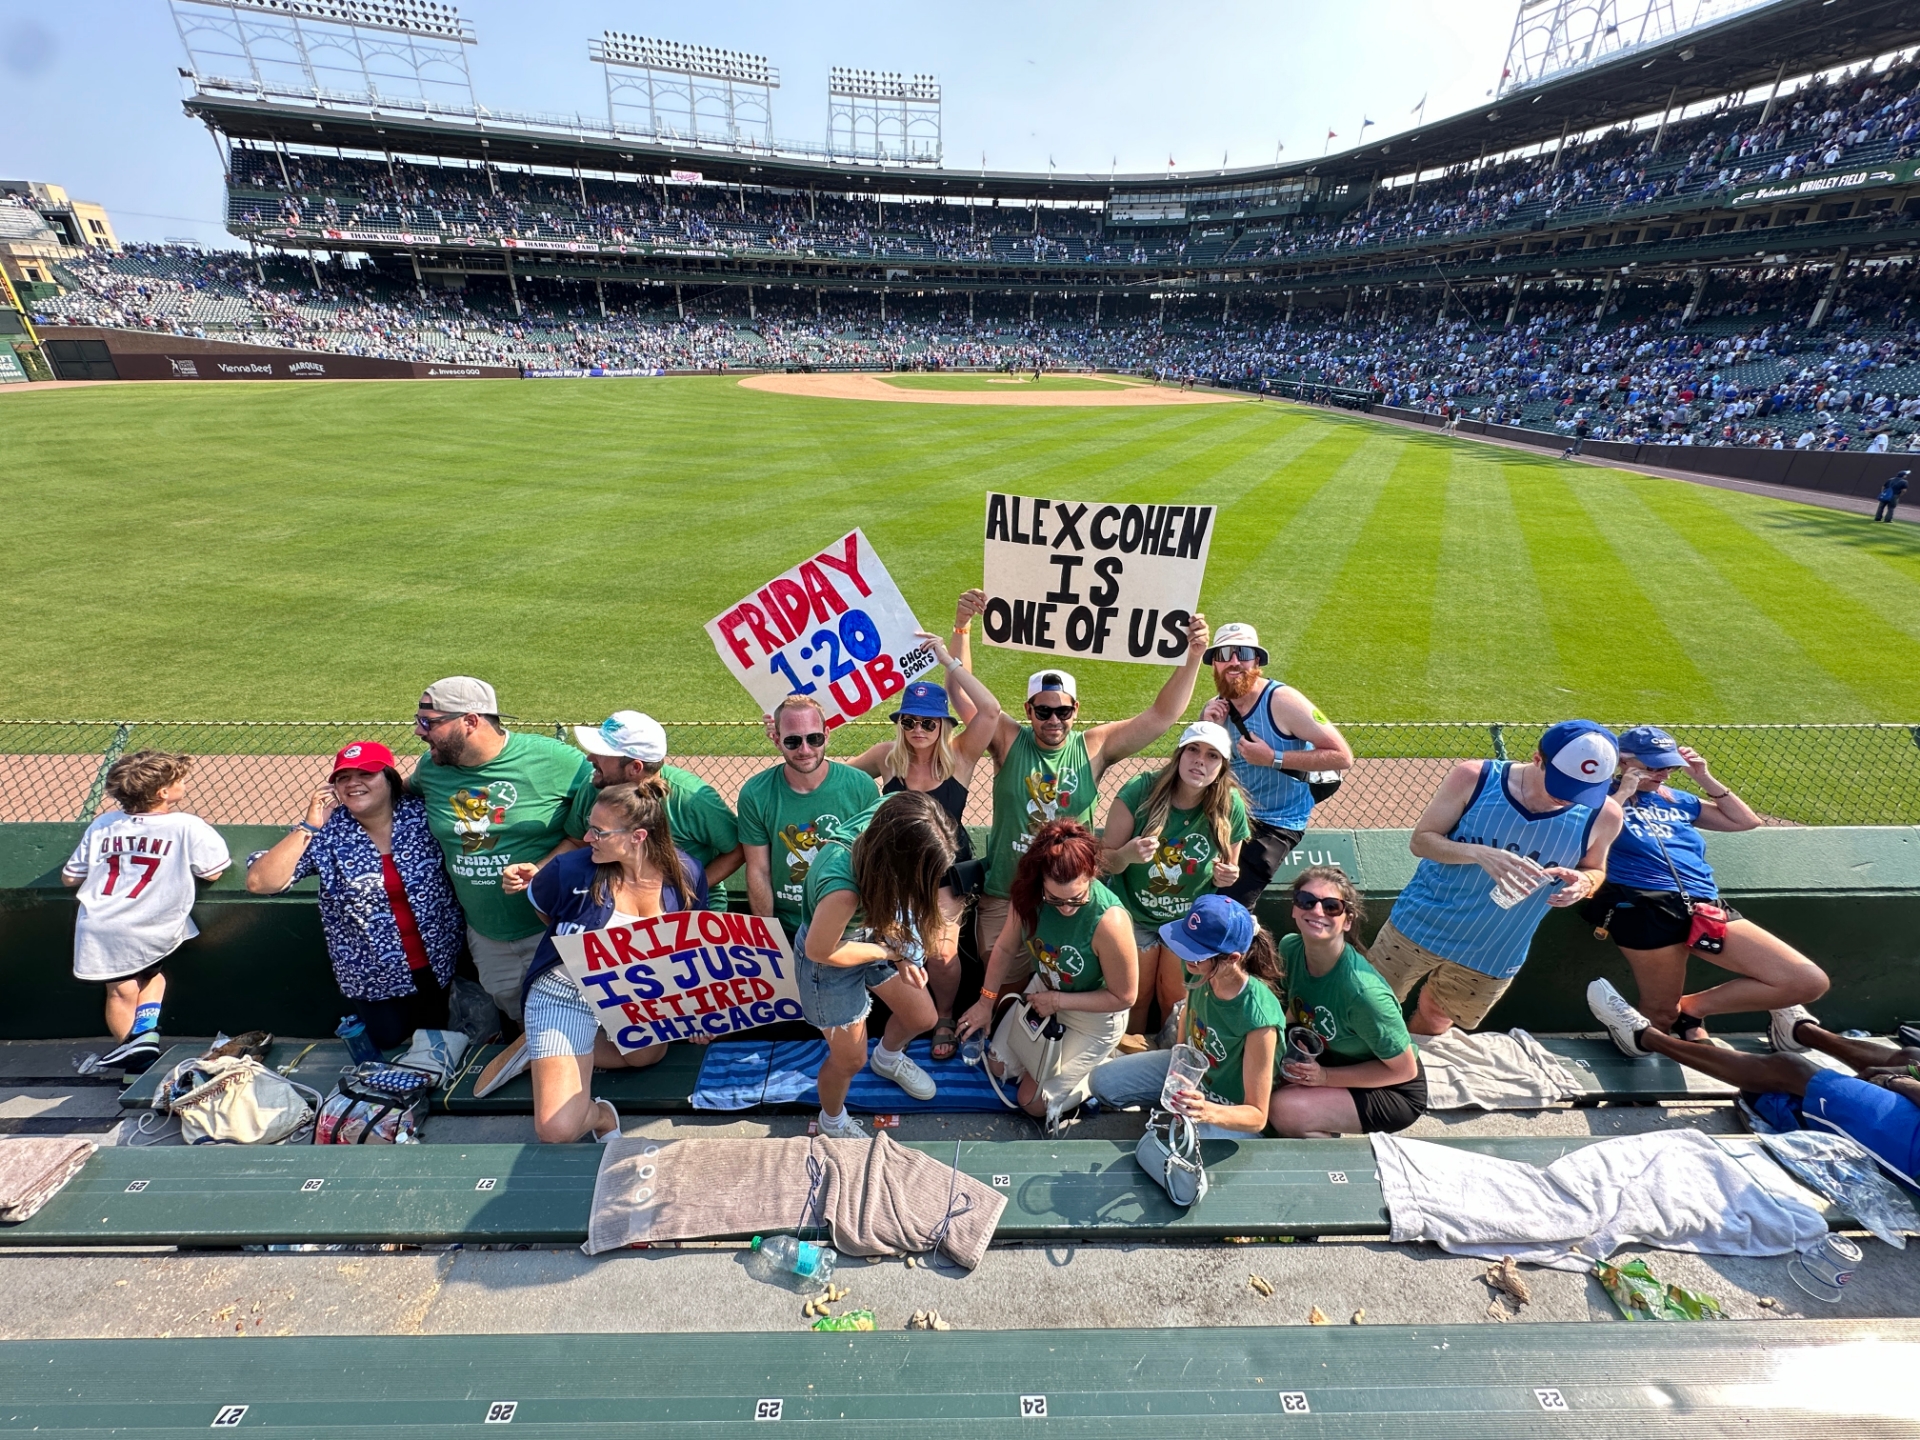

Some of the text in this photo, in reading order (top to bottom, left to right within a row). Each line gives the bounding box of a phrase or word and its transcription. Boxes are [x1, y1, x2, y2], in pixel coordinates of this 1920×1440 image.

[1755, 171, 1868, 199] Welcome to WRIGLEY FIELD
[350, 232, 379, 241] THANK
[413, 235, 436, 243] FANS!
[523, 240, 549, 248] THANK
[576, 243, 597, 251] FANS!
[217, 363, 273, 375] Vienna Beef
[288, 361, 326, 373] MARQUEE
[986, 493, 1212, 560] ALEX COHEN
[1046, 554, 1123, 608] IS
[717, 532, 872, 670] FRIDAY
[983, 596, 1190, 658] ONE OF US
[769, 608, 881, 696] 1:20
[903, 653, 935, 679] SPORTS
[1580, 759, 1599, 775] C
[101, 836, 173, 856] OHTANI
[456, 854, 511, 866] FRIDAY
[101, 854, 161, 899] 17
[1187, 912, 1201, 931] C
[582, 910, 780, 971] ARIZONA
[581, 945, 784, 1009] IS JUST
[620, 977, 775, 1025] RETIRED
[616, 998, 804, 1049] CHICAGO
[127, 1173, 1346, 1191] 29 28 27 24 22
[214, 1391, 1565, 1425] 27 26 25 24 23 22
